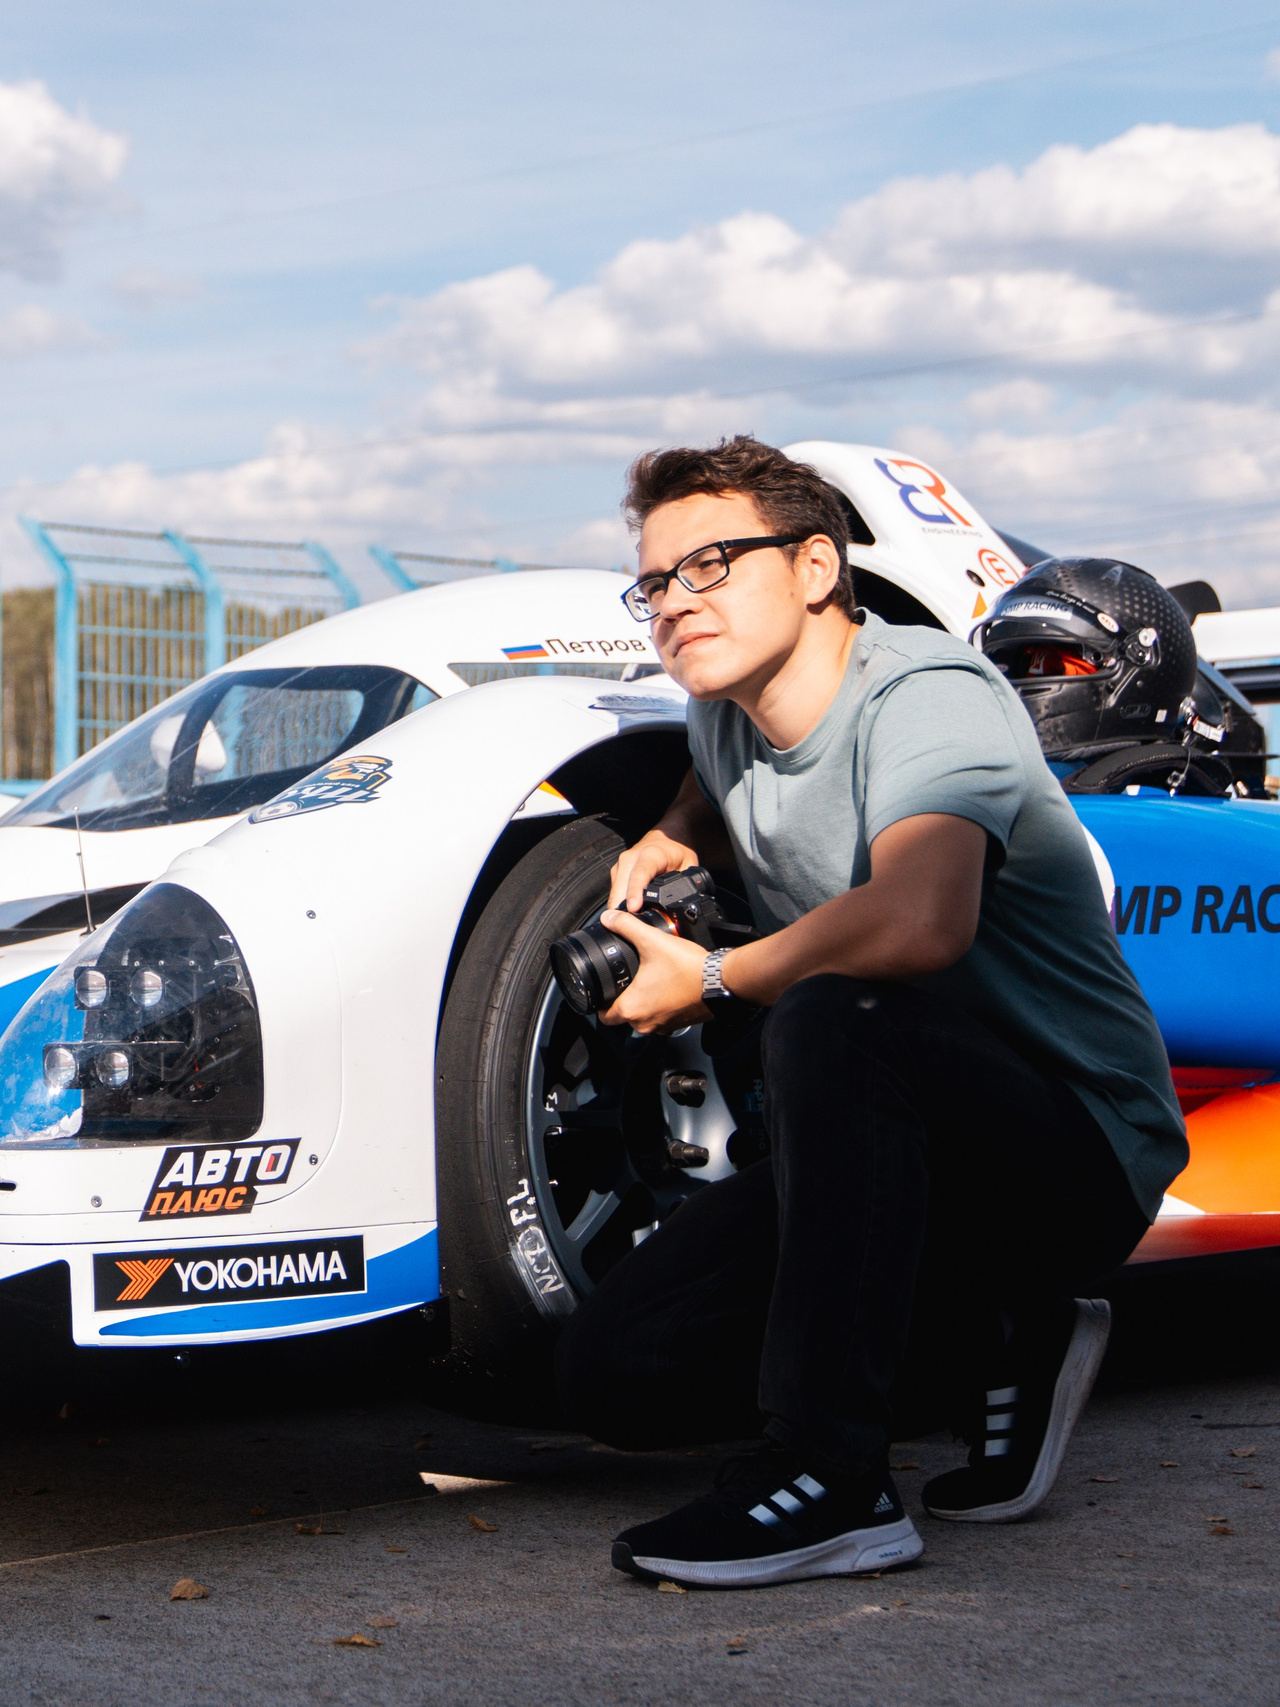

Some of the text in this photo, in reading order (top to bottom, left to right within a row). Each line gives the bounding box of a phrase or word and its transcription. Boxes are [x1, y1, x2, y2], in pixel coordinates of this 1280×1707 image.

[921, 526, 983, 538] ENGINEERING
[1023, 601, 1070, 612] RACING
[545, 638, 647, 656] Петров
[158, 1144, 292, 1188] АВТО
[148, 1186, 248, 1215] ПЛЮС
[174, 1251, 347, 1293] YOKOHAMA
[874, 1502, 894, 1513] adidas
